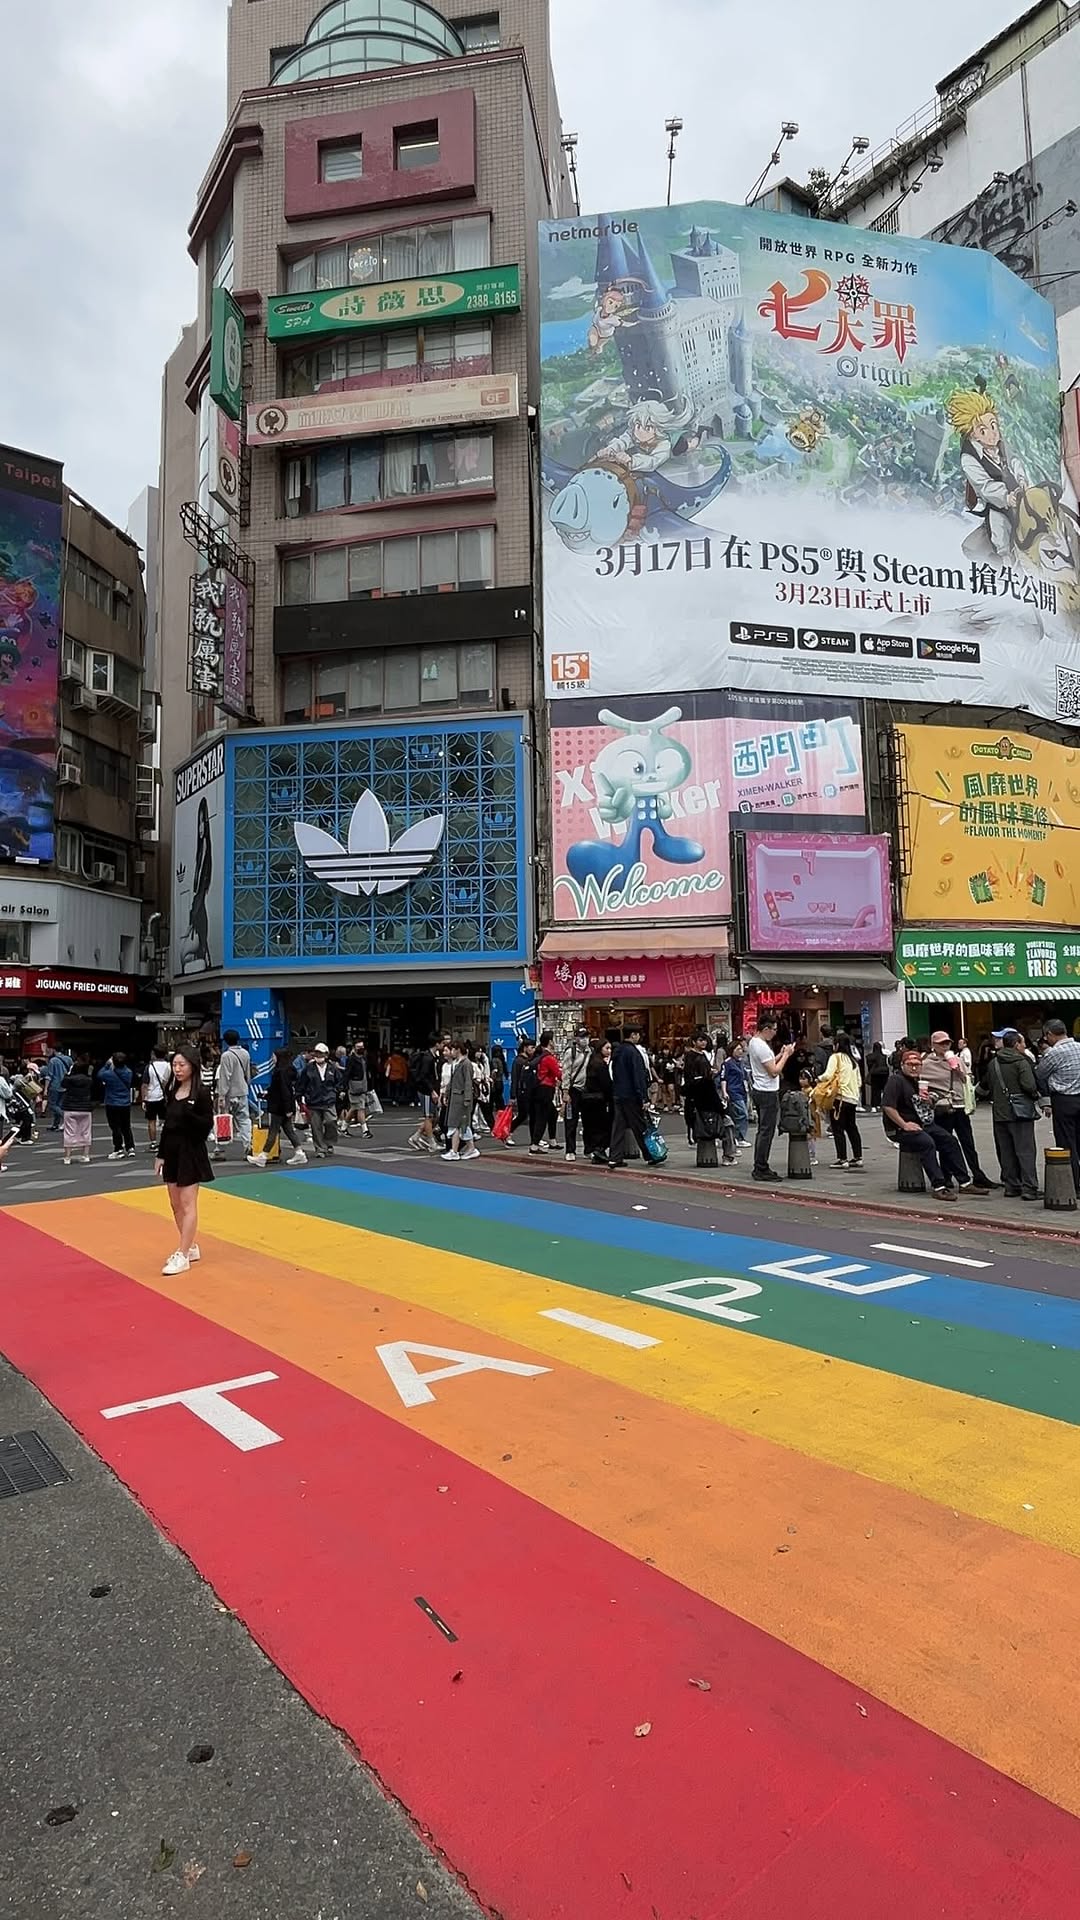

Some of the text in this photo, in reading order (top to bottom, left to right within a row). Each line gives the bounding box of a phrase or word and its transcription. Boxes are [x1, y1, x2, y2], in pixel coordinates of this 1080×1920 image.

[549, 219, 638, 242] netmarble
[759, 236, 918, 276] 開放世界 RPG 全新力作
[338, 285, 447, 318] 詩薇思
[466, 290, 517, 309] 2388-8155
[284, 316, 311, 329] SPA
[757, 267, 919, 364] 七大罪
[836, 355, 912, 388] Origin
[4, 462, 57, 488] Taipei
[595, 536, 711, 578] 3月17日
[720, 535, 753, 569] 在
[836, 548, 867, 583] 與
[873, 553, 966, 590] Steam
[969, 562, 1057, 615] 搶先公開
[775, 581, 932, 616] 3月23日正式上市
[754, 630, 789, 642] PS5
[820, 636, 849, 647] STEAM
[876, 638, 910, 648] App Store
[935, 641, 977, 655] Google Play
[733, 716, 860, 778] 西門町
[176, 743, 224, 803] SUPERSTAR
[737, 777, 804, 797] XIMEN-WALKER
[963, 773, 1038, 800] 風靡世界
[1002, 828, 1017, 838] THE
[554, 863, 724, 919] Welcome
[20, 905, 49, 916] Salon
[1063, 945, 1080, 957] 全球
[1027, 959, 1058, 977] FRIES
[36, 979, 129, 994] JIGUANG FRIED CHICKEN
